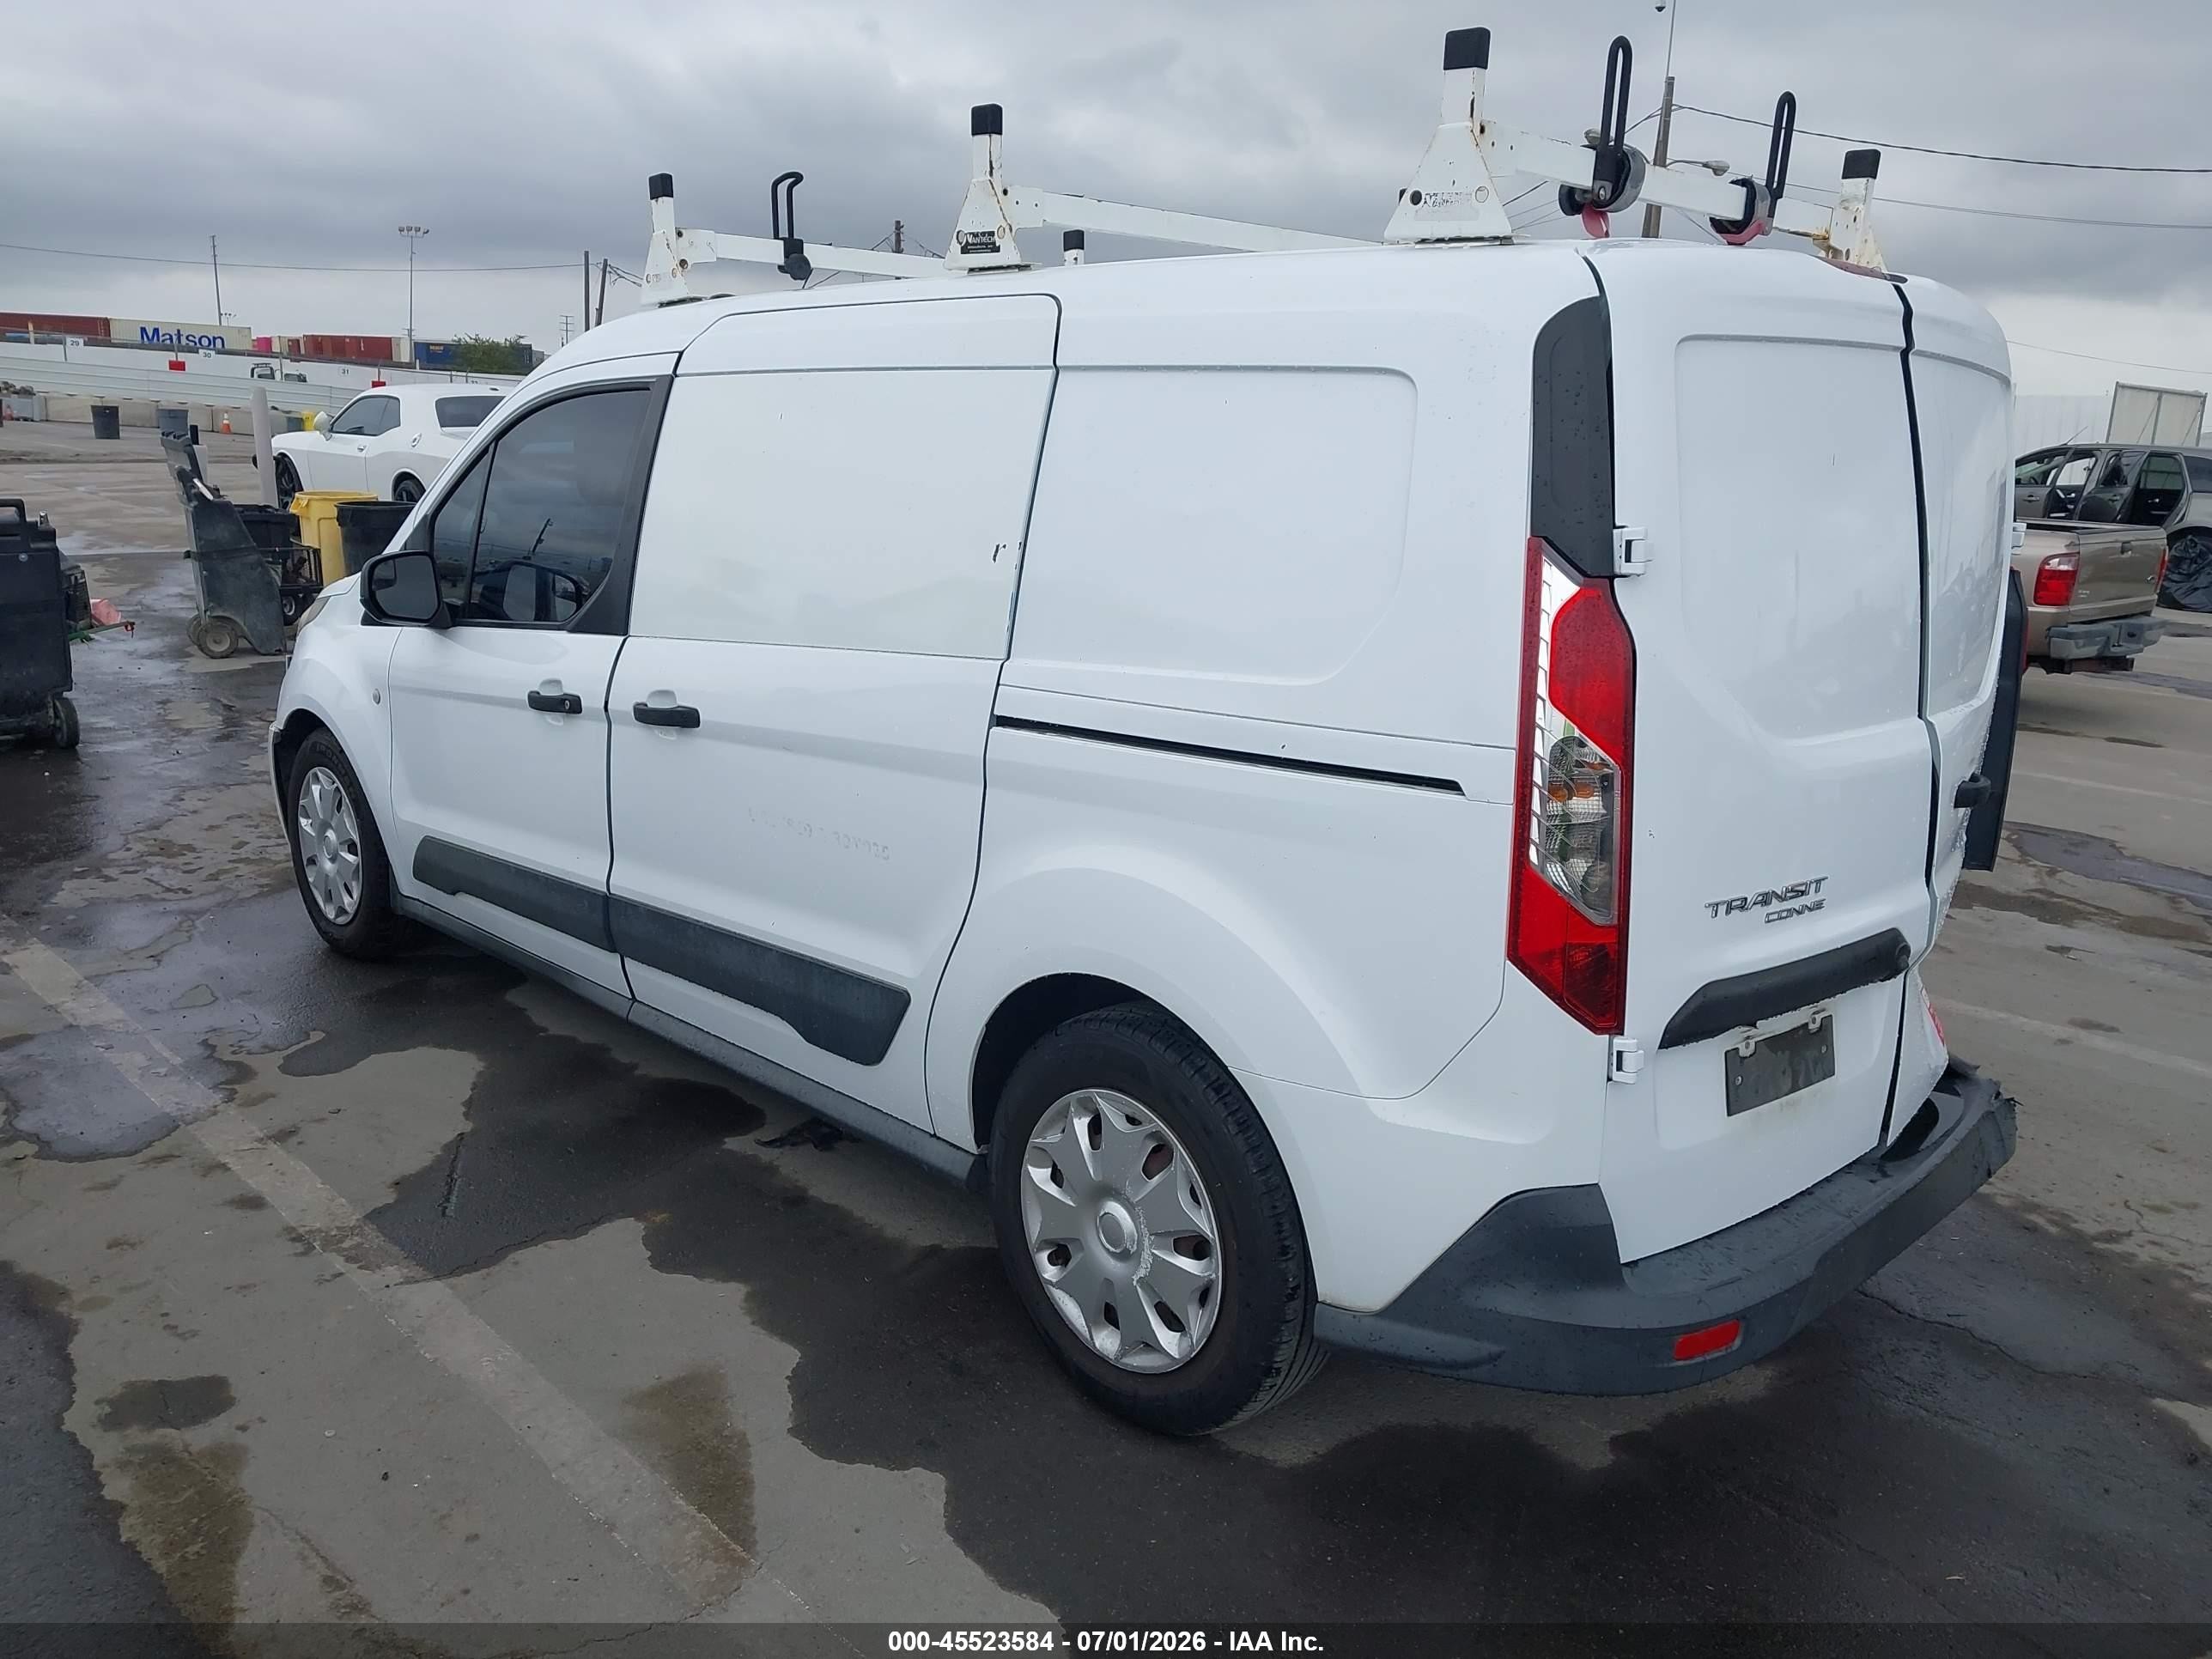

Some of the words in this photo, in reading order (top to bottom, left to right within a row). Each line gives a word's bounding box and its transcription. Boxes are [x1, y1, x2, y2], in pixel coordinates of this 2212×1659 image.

[140, 326, 226, 349] Matson
[1705, 876, 1828, 919] TRANSIT
[1765, 898, 1826, 923] CONNE
